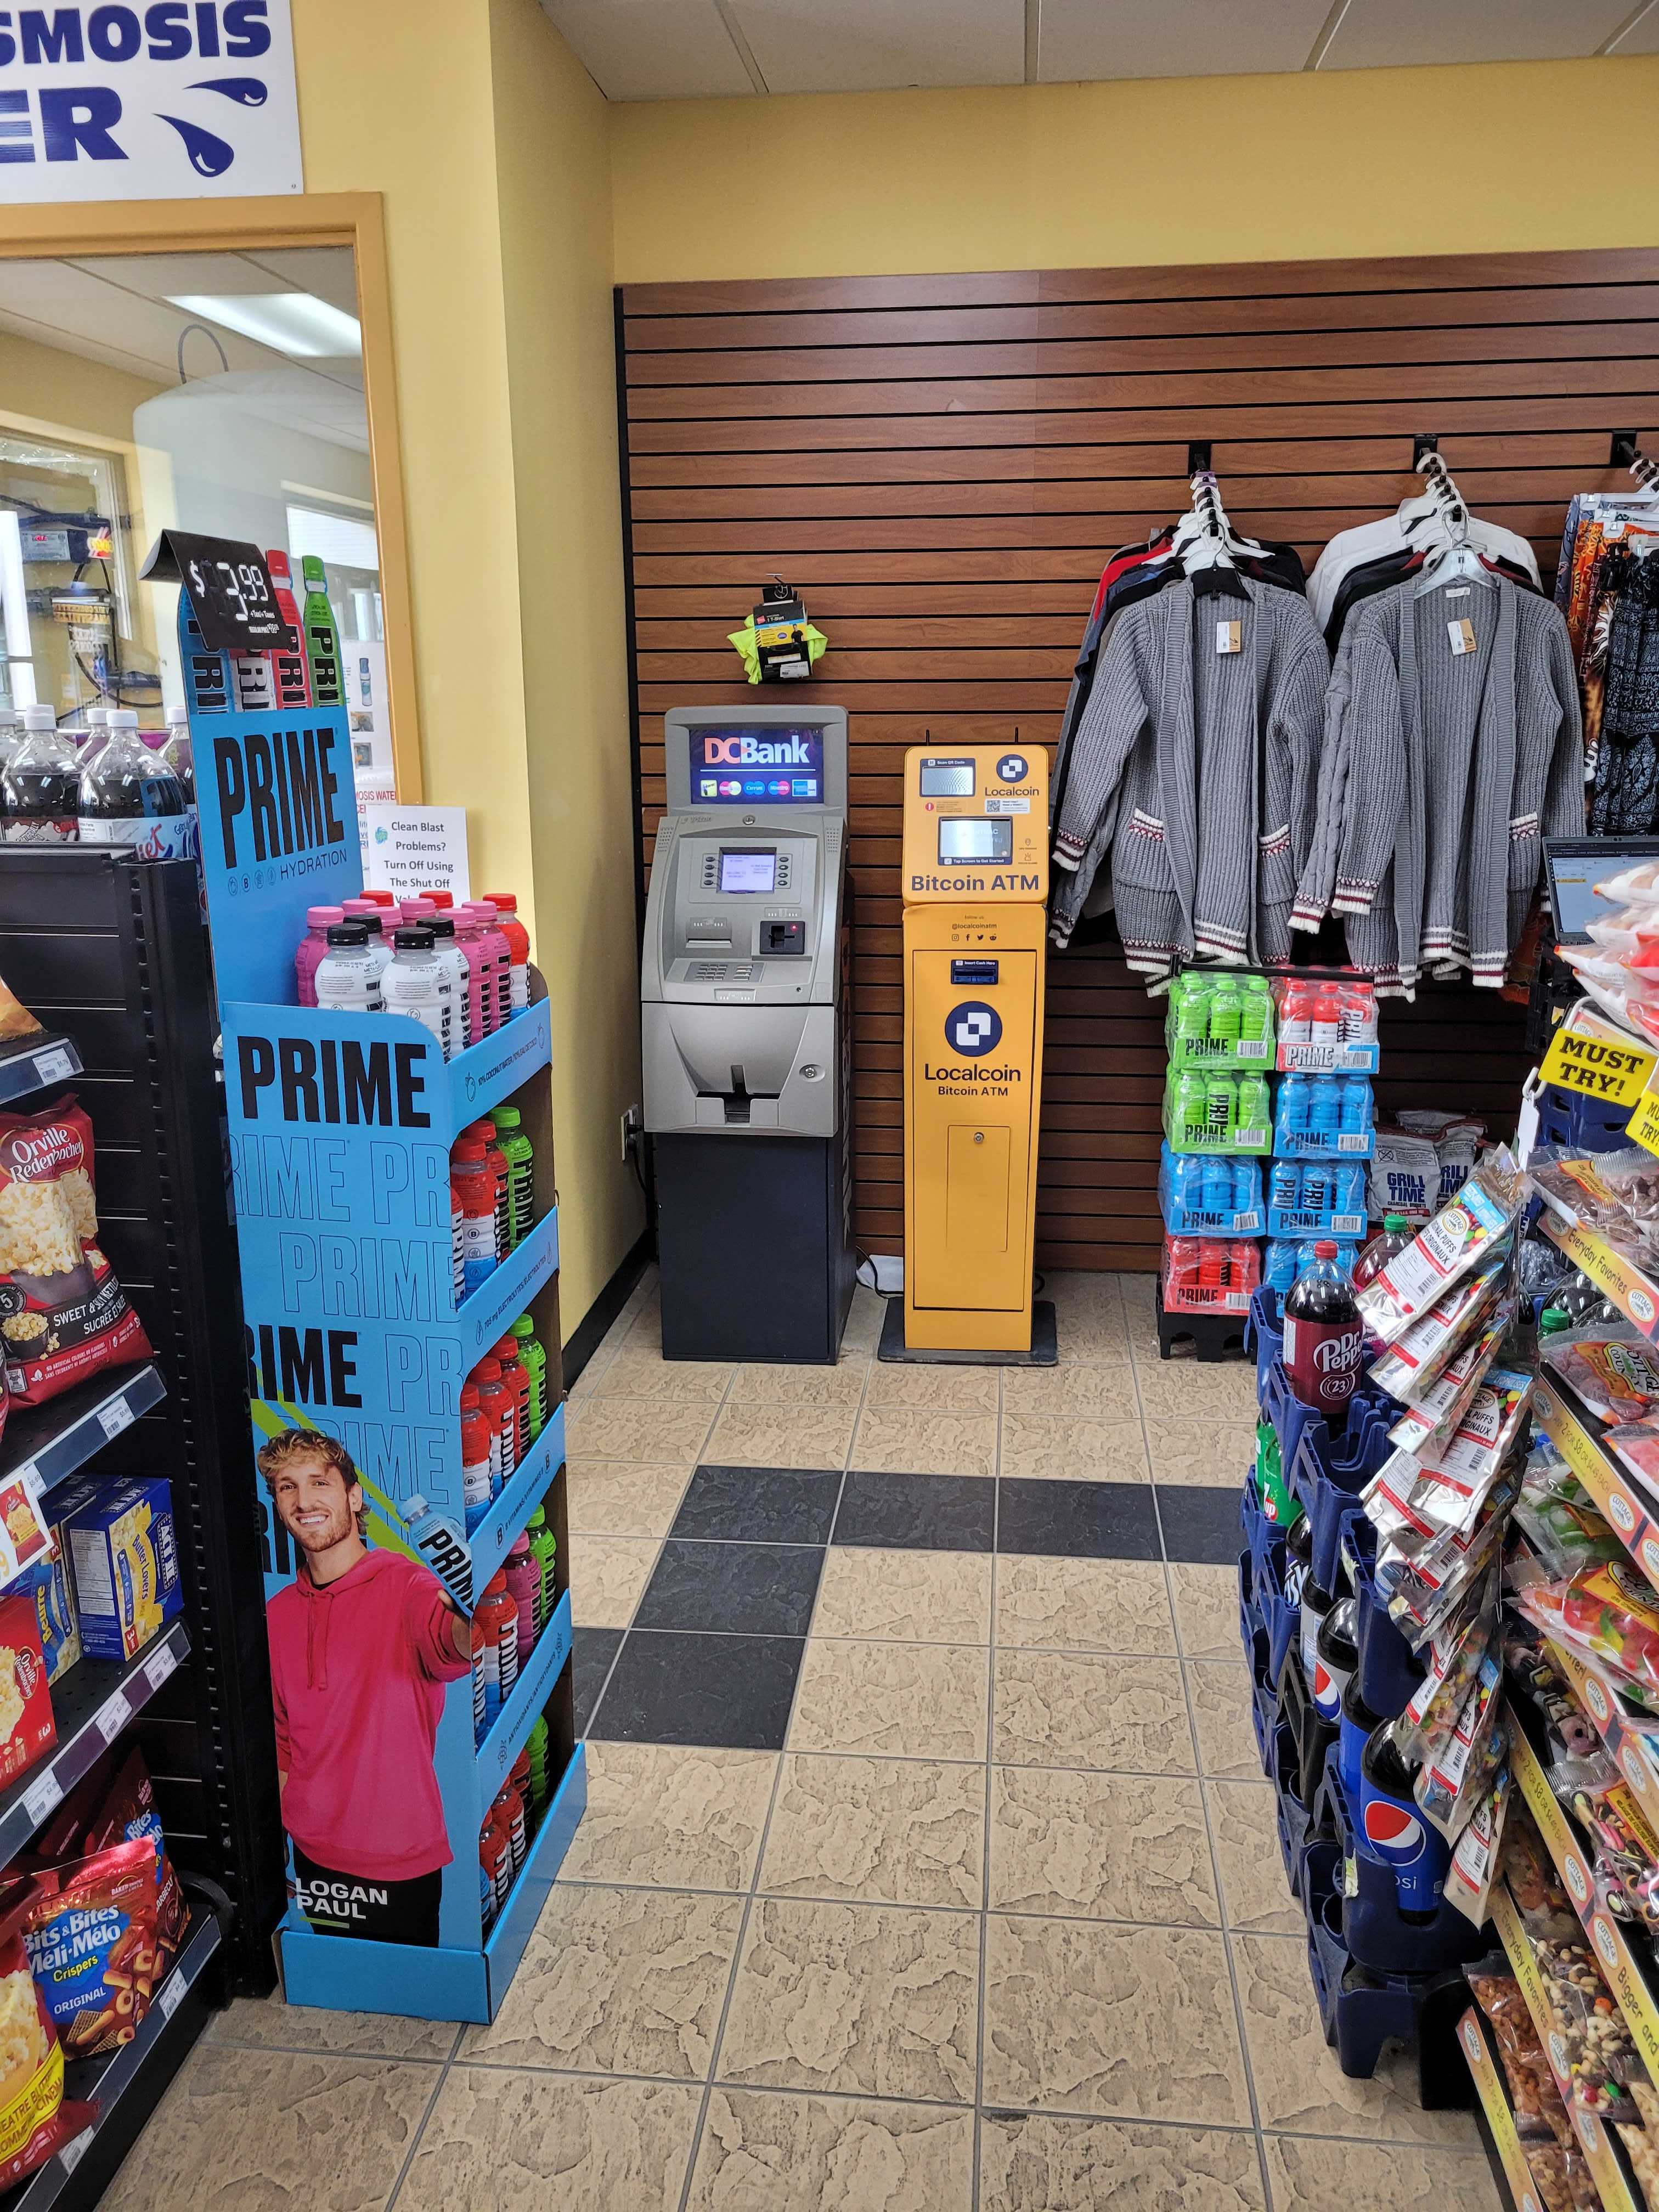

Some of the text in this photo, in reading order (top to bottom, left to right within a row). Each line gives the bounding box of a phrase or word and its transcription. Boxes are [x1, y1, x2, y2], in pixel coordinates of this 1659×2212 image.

[311, 625, 341, 708] PRI
[704, 735, 810, 764] DCBank
[213, 727, 344, 869] PRIME
[356, 791, 396, 800] OSIS WATE
[985, 787, 1039, 796] Localcoin
[391, 822, 444, 832] Clean Blast
[396, 842, 446, 851] Problems?
[280, 849, 347, 880] HYDRATION
[384, 860, 454, 873] Turn Off Using
[390, 878, 450, 888] The Shut Off
[912, 875, 1039, 891] Bitcoin ATM
[1186, 1038, 1229, 1056] PRIME
[1287, 1046, 1334, 1068] PRIME
[1559, 1036, 1644, 1074] MUST
[238, 1036, 431, 1128] PRIME
[925, 1064, 1021, 1082] Localcoin
[1560, 1062, 1625, 1097] TRY!
[938, 1086, 1008, 1096] Bitcoin ATM
[1209, 1094, 1229, 1125] PRI
[12, 1127, 70, 1164] Orville
[1185, 1125, 1228, 1142] PRIME
[1286, 1132, 1330, 1150] PRIME
[9, 1141, 83, 1184] Redenbacher
[1387, 1172, 1425, 1188] GRILL
[1389, 1187, 1425, 1203] TIME
[1182, 1211, 1225, 1229] PRIME
[1280, 1212, 1322, 1229] PRIME
[1440, 1231, 1457, 1253] PUFFS
[280, 1232, 461, 1323] PRIME
[1567, 1229, 1597, 1266] Everyday
[1595, 1255, 1628, 1295] Favorites
[1632, 1291, 1653, 1313] COTTAGE
[1177, 1288, 1218, 1305] PRIME
[54, 1305, 87, 1327] SWEET
[89, 1302, 96, 1313] &
[1313, 1339, 1363, 1373] Peppe
[1340, 1331, 1360, 1355] Dr
[1332, 1380, 1346, 1393] 23
[1472, 1412, 1494, 1424] PUFFS
[1561, 1422, 1568, 1436] 2
[1612, 1496, 1632, 1523] COTTAGE
[132, 1533, 150, 1600] Butter Lovers
[15, 1655, 32, 1697] Redenbacher
[21, 1654, 36, 1685] Orville
[1589, 1681, 1606, 1713] COTTAGE
[127, 1809, 151, 1841] Bites
[1568, 1858, 1585, 1892] COTTAGE
[296, 1877, 388, 1905] LOGAN
[62, 1925, 69, 1937] &
[70, 1904, 120, 1934] Bites
[297, 1894, 366, 1920] PAUL
[53, 1955, 98, 1982] Crispers
[1501, 1910, 1548, 2028] Everyday Favorites
[54, 1987, 106, 2015] ORIGINAL
[1598, 1921, 1659, 2056] COTTAGE Bigger and
[0, 2098, 31, 2133] EATRE
